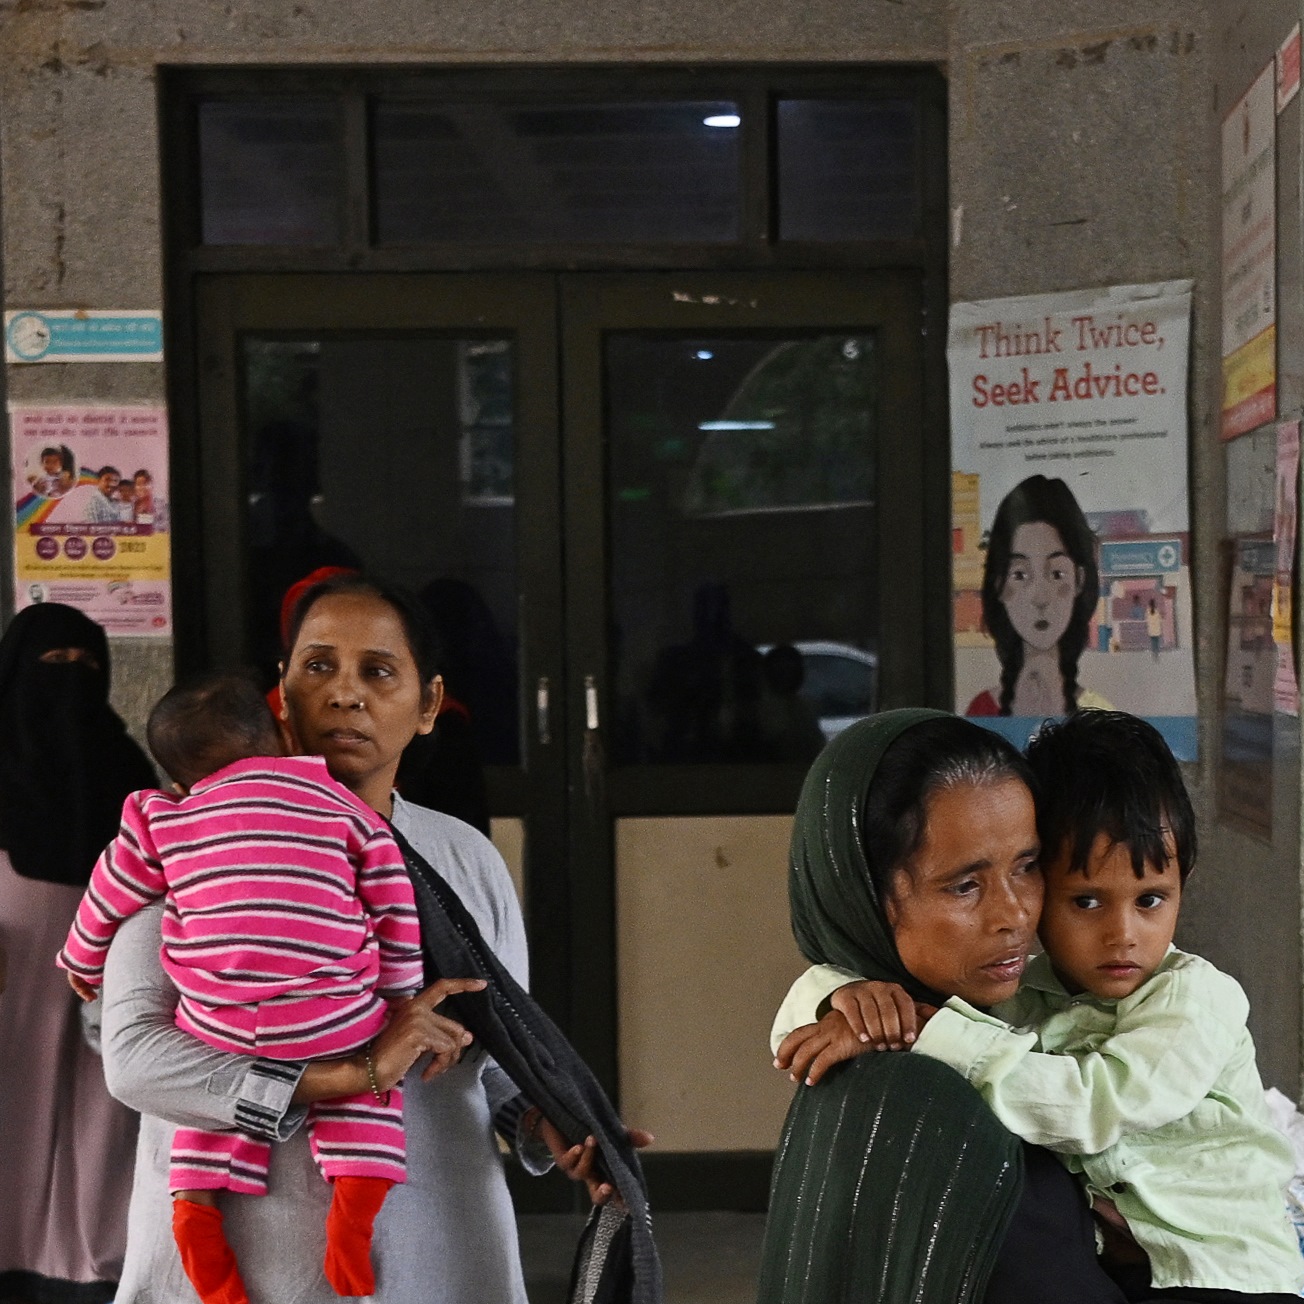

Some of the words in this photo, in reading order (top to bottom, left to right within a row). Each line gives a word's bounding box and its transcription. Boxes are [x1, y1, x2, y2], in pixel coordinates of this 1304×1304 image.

[974, 316, 1063, 359] Think
[1072, 315, 1165, 351] Twice,
[972, 367, 1040, 408] Seek
[1049, 362, 1166, 401] Advice.
